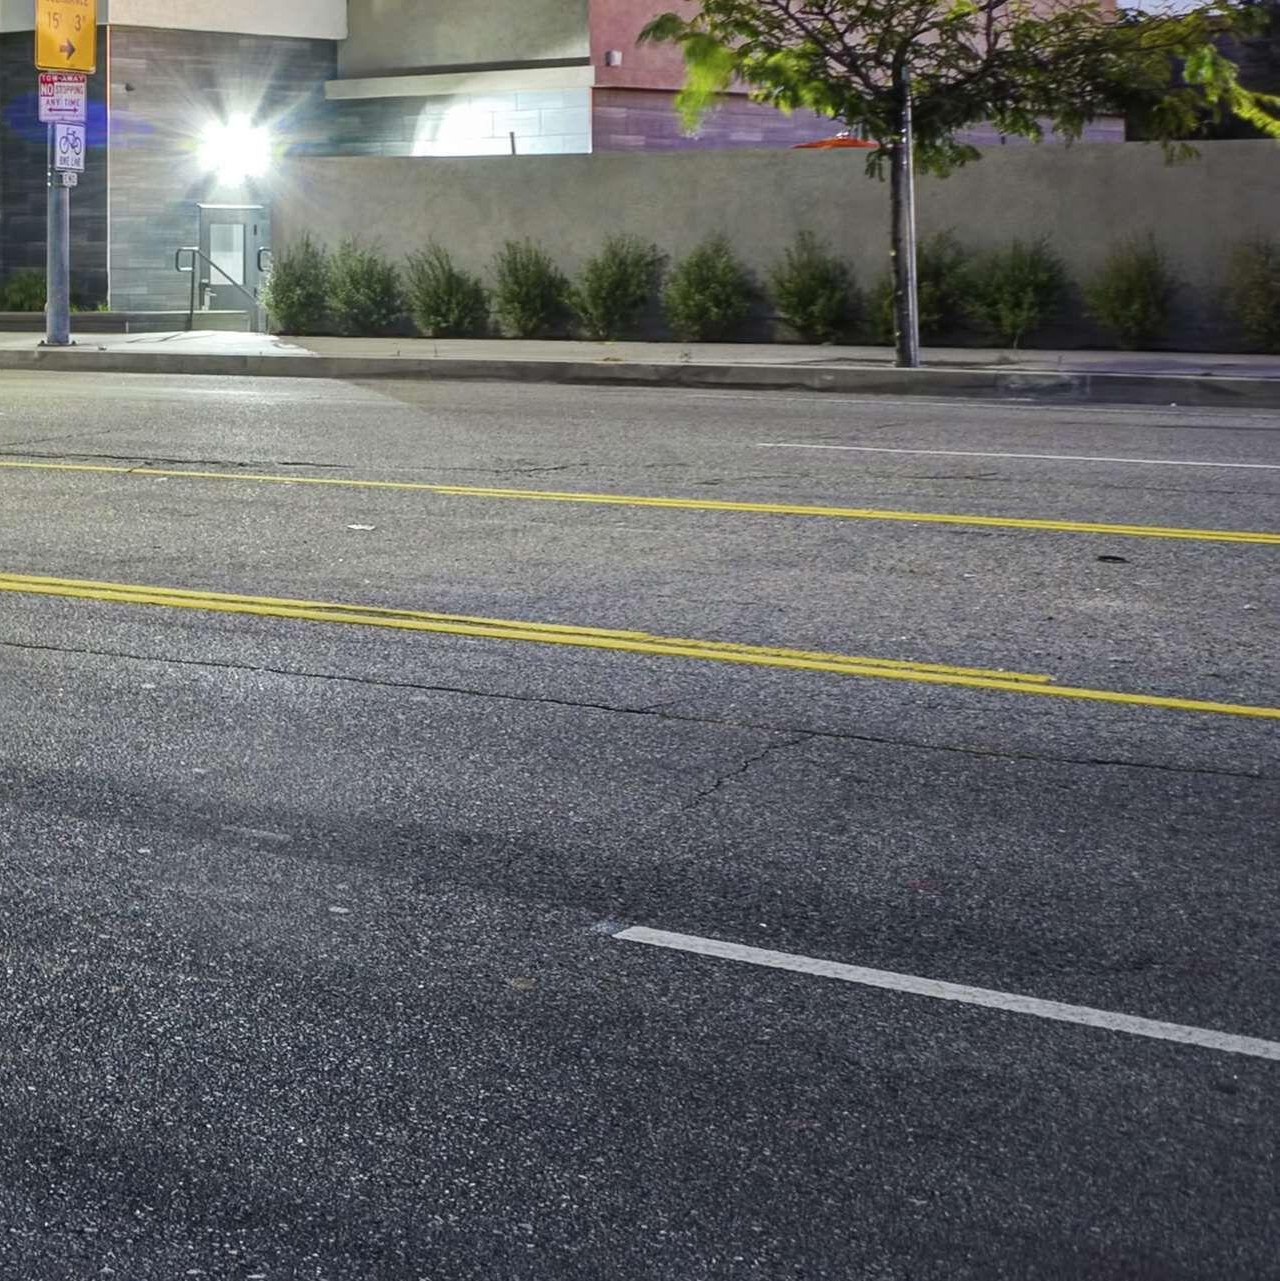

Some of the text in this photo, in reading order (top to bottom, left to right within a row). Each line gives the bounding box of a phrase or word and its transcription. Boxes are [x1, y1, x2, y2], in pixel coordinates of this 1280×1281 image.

[41, 83, 83, 95] NO STOPPING
[45, 98, 80, 107] ANY TIME
